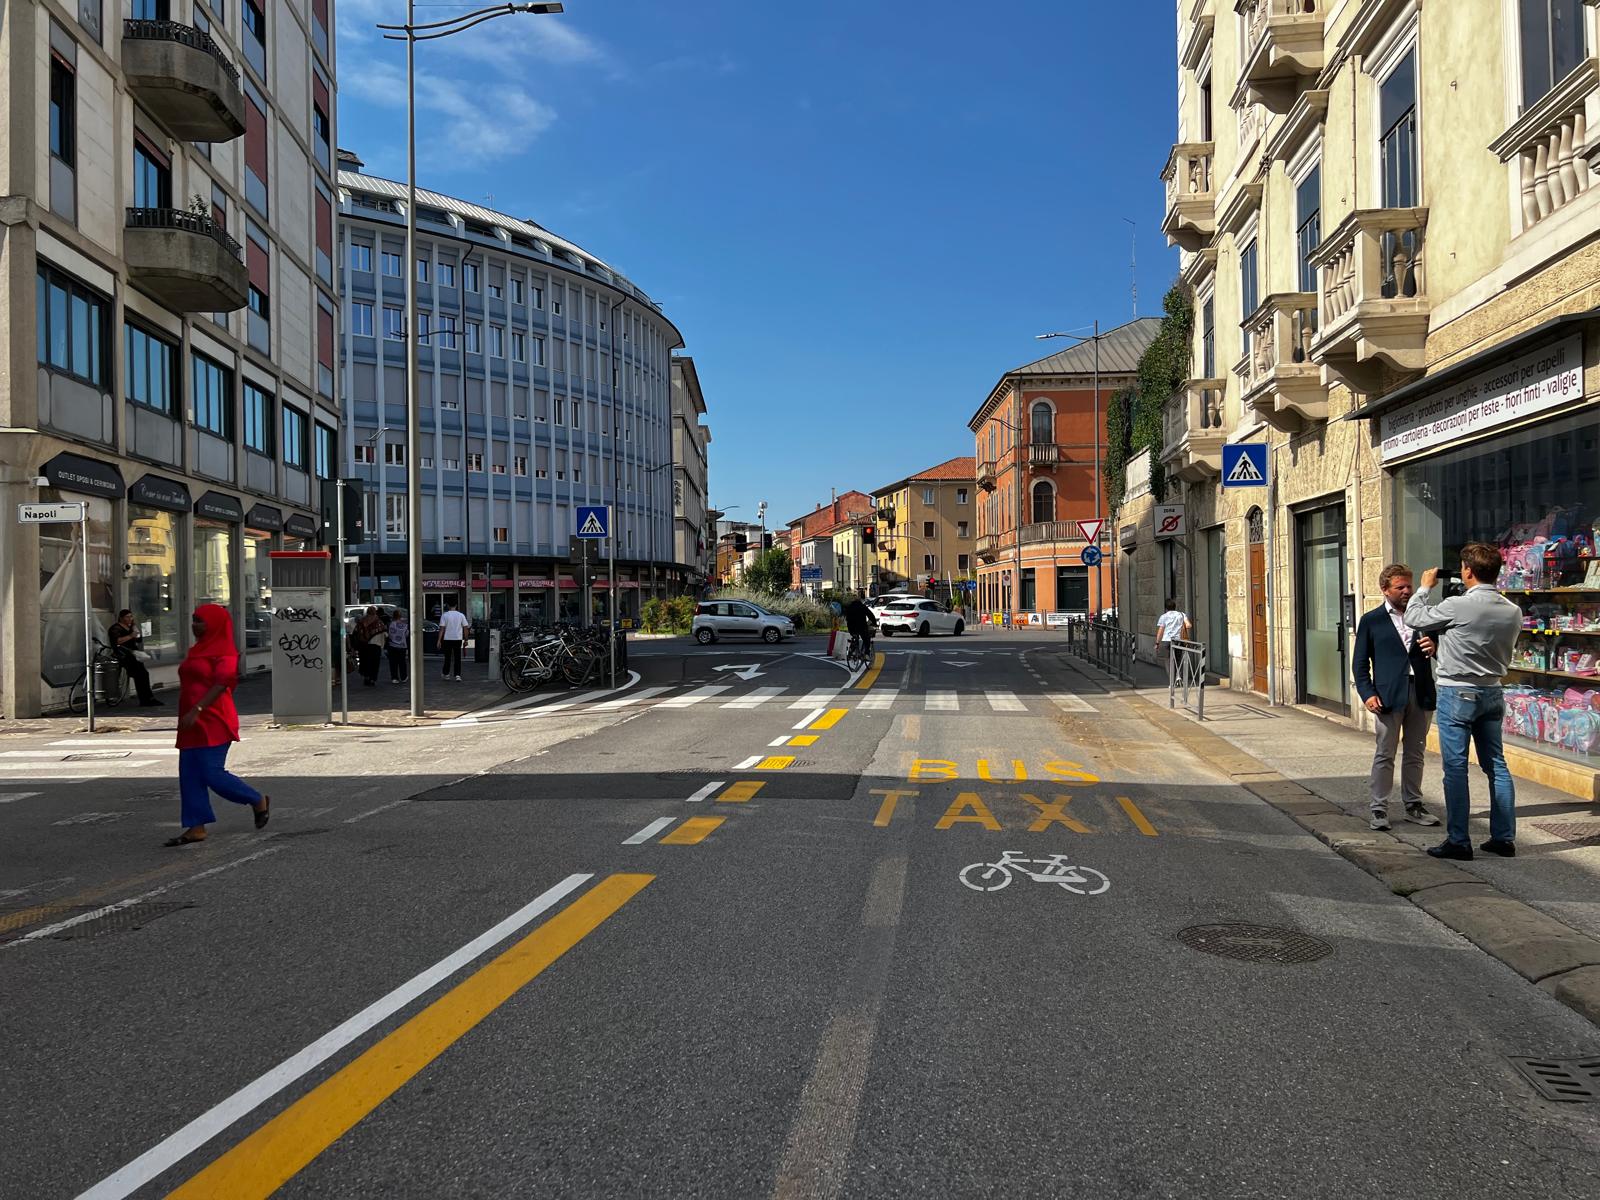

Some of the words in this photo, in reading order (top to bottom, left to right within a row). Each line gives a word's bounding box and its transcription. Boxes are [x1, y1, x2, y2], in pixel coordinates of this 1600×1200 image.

[1418, 400, 1443, 423] prodotti
[1444, 396, 1454, 413] per
[1456, 385, 1477, 407] unghie
[1484, 367, 1519, 394] accessori
[1520, 365, 1534, 385] per
[1536, 348, 1565, 375] capelli
[1402, 427, 1428, 444] cartoleria
[1432, 411, 1468, 434] decorazioni
[1468, 407, 1479, 426] per
[1481, 400, 1500, 417] feste
[1505, 389, 1522, 409] fiori
[1524, 382, 1541, 402] finti
[1547, 371, 1577, 395] valigie
[58, 471, 76, 481] OUTLET
[24, 510, 57, 519] Napoli
[907, 759, 1100, 787] BUS
[869, 788, 1159, 836] TAXI
